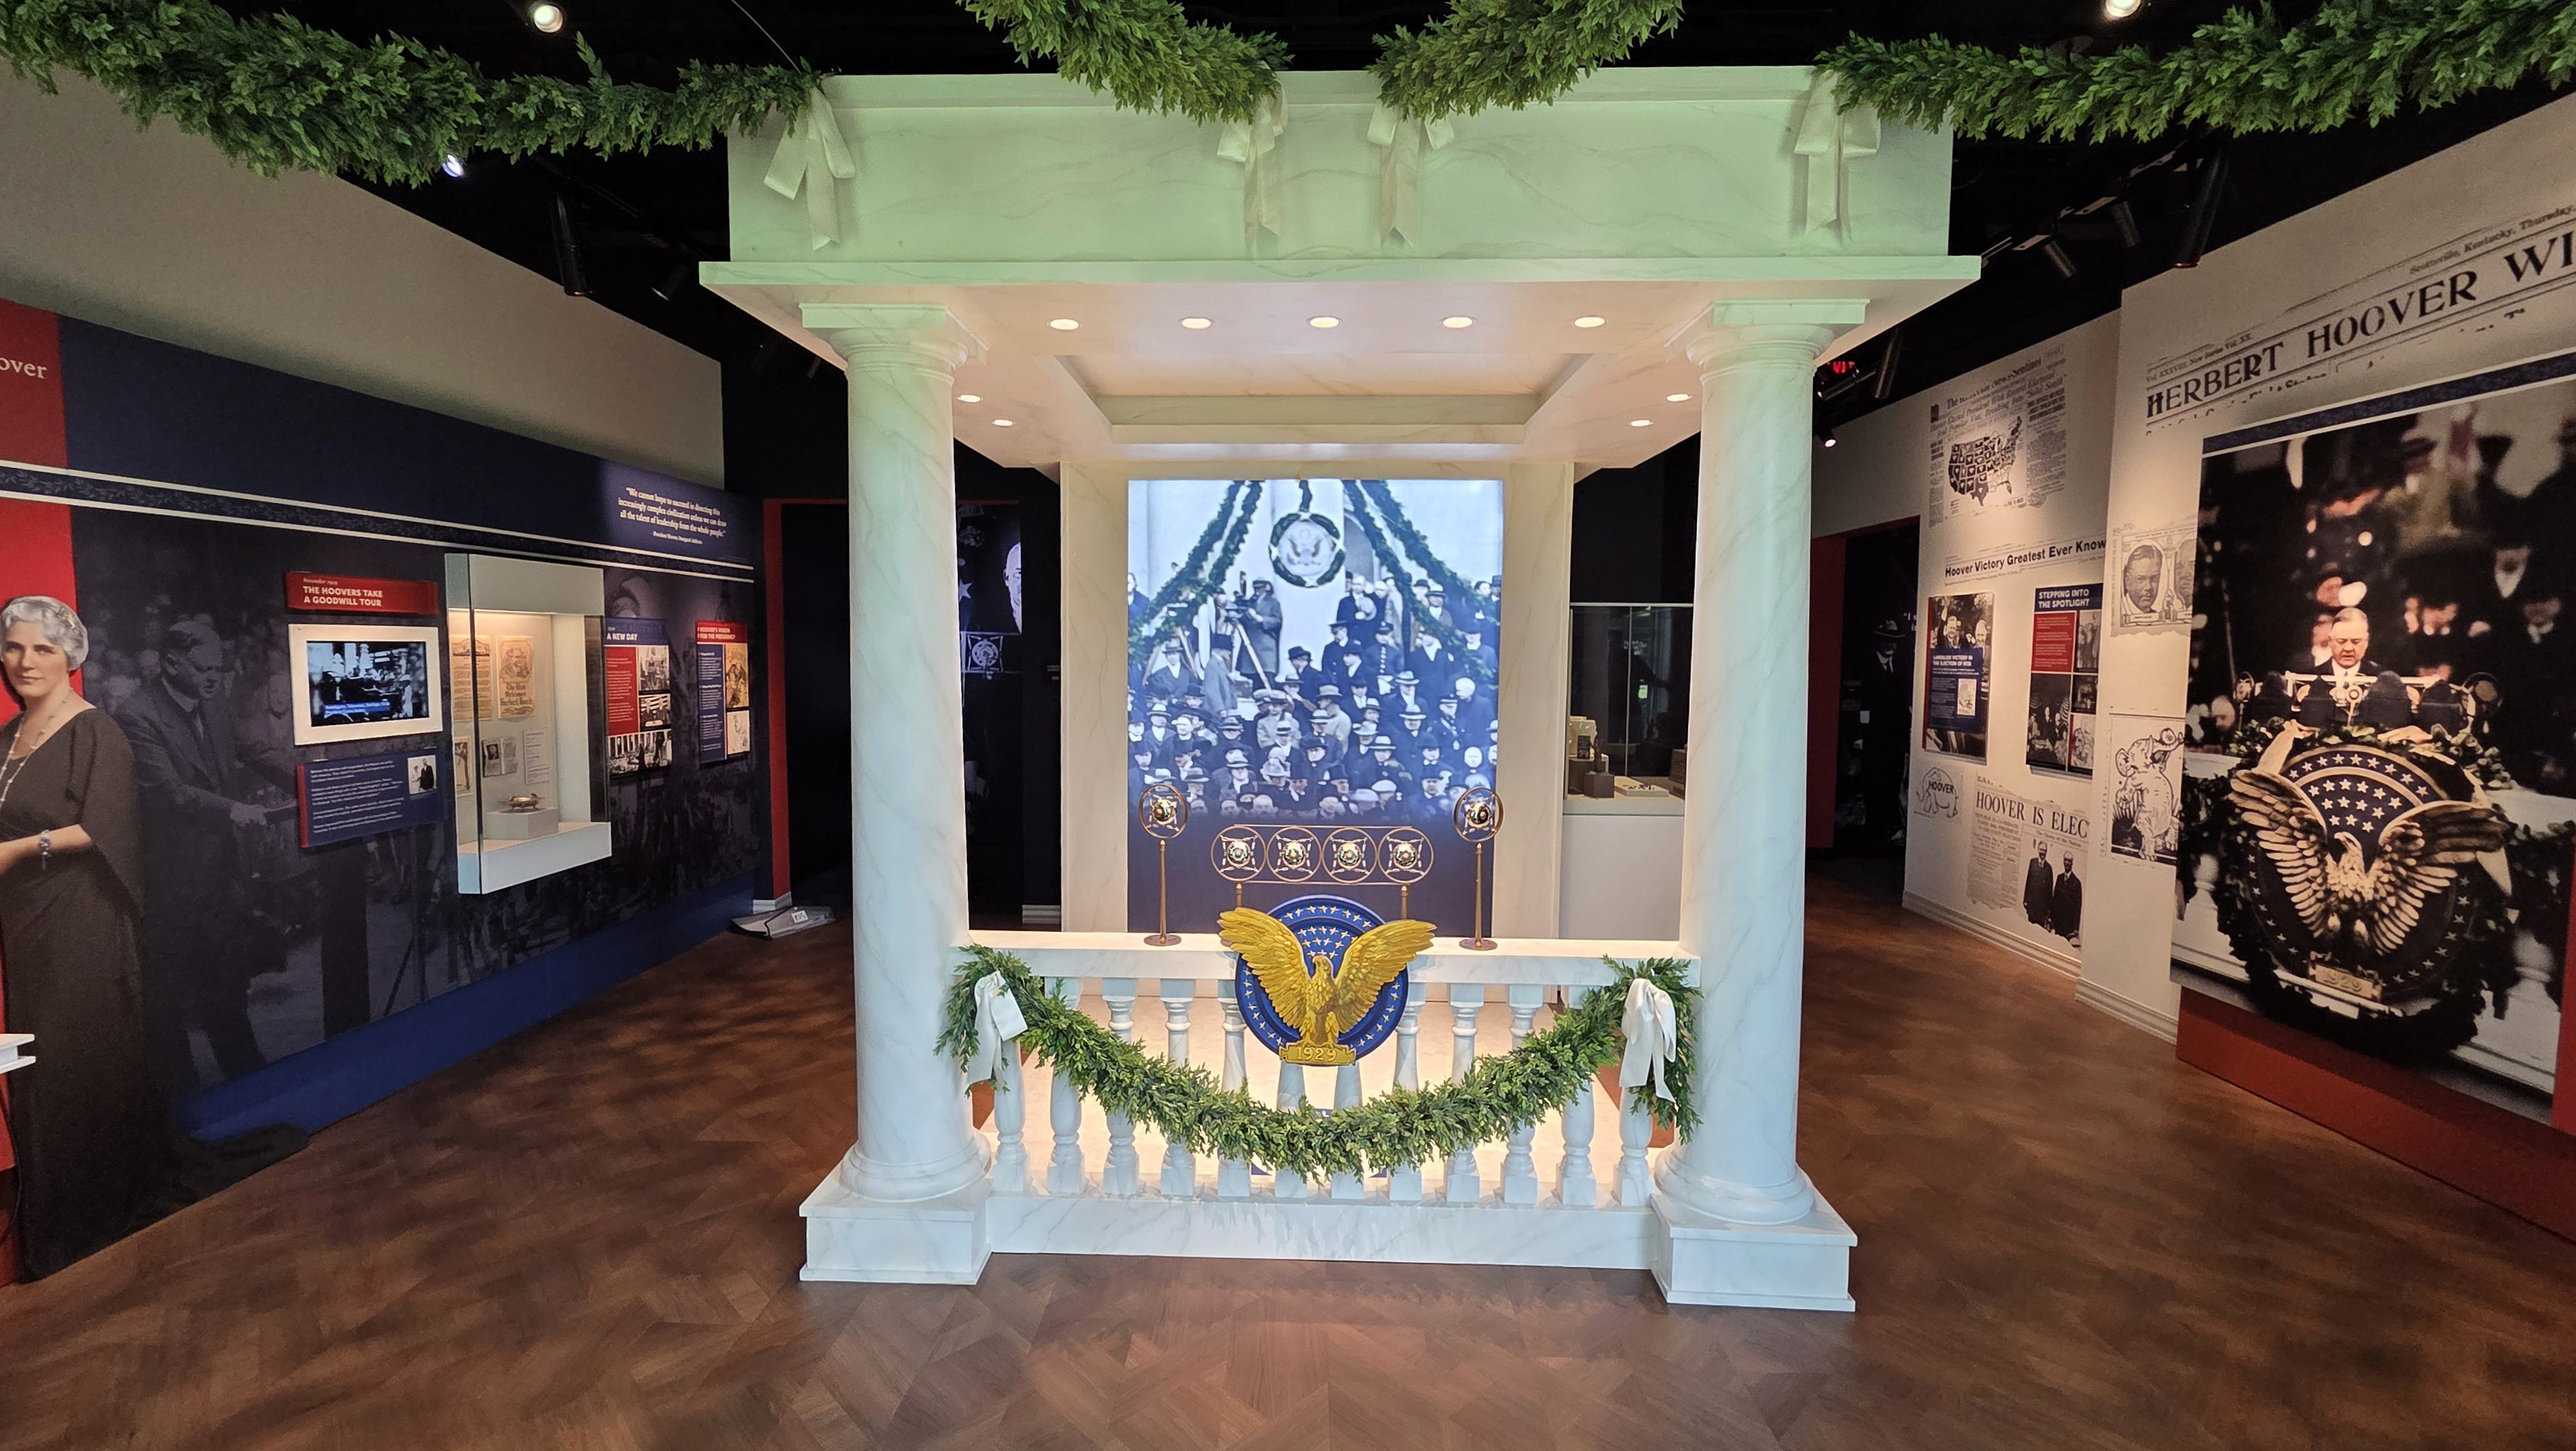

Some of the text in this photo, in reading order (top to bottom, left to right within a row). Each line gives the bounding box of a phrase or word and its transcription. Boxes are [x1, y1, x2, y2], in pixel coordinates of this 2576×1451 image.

[2146, 230, 2575, 418] HERBERT HOOVER WI
[0, 357, 48, 379] over
[1945, 564, 1973, 578] Hoover
[1975, 559, 2005, 572] Victory
[2007, 548, 2046, 566] Greatest
[2048, 544, 2073, 559] Ever
[2075, 538, 2106, 553] Know
[302, 585, 383, 598] THE HOOVERS TAKE
[2039, 589, 2089, 599] STEPPING INTO
[304, 595, 382, 607] A GOODWILL TOUR
[2038, 599, 2090, 609] THE SPOTLIGHT
[607, 632, 611, 640] A
[1928, 780, 1954, 795] HOOVER
[1976, 791, 2025, 821] HOOVER
[2032, 806, 2044, 826] IS
[2051, 811, 2089, 838] ELEC
[1296, 1047, 1337, 1063] 1929
